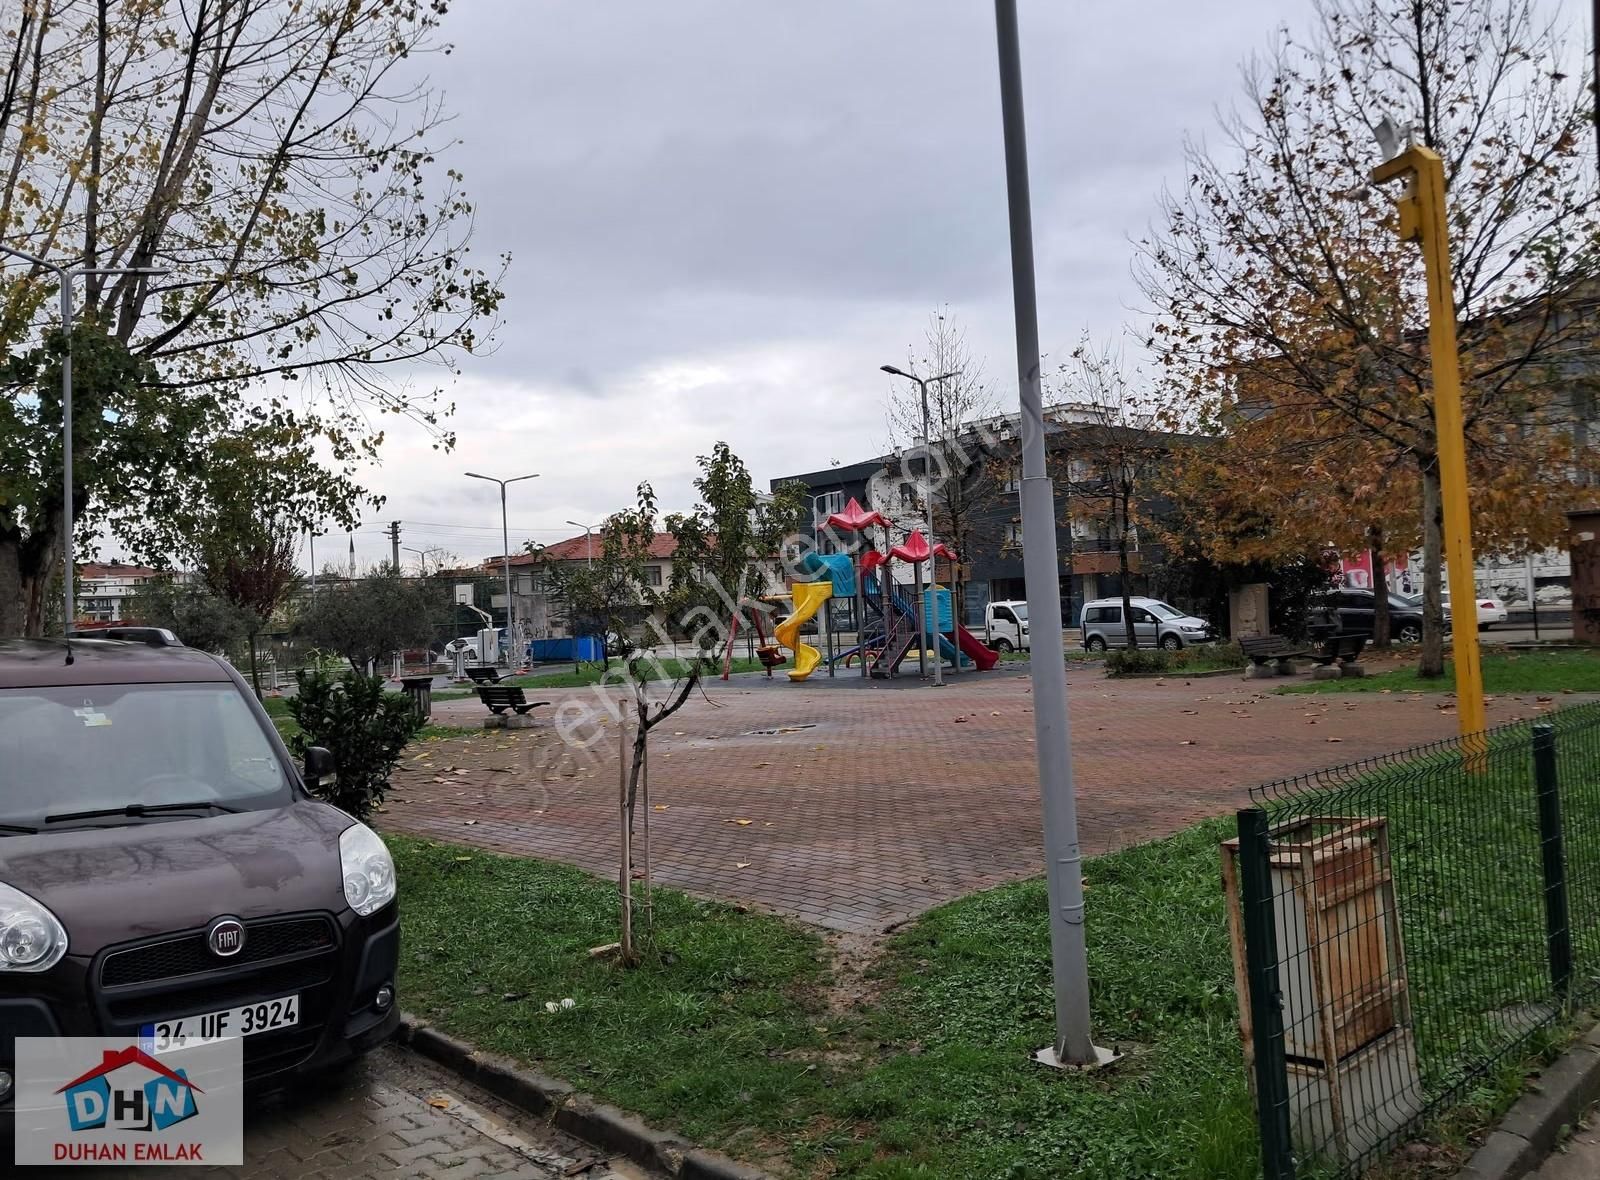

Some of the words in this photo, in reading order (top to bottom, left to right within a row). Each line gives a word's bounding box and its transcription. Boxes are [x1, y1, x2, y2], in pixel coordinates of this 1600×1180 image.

[218, 930, 238, 948] FIAT
[156, 1021, 187, 1050] 34
[201, 1012, 230, 1042] UF
[240, 998, 296, 1034] 3924
